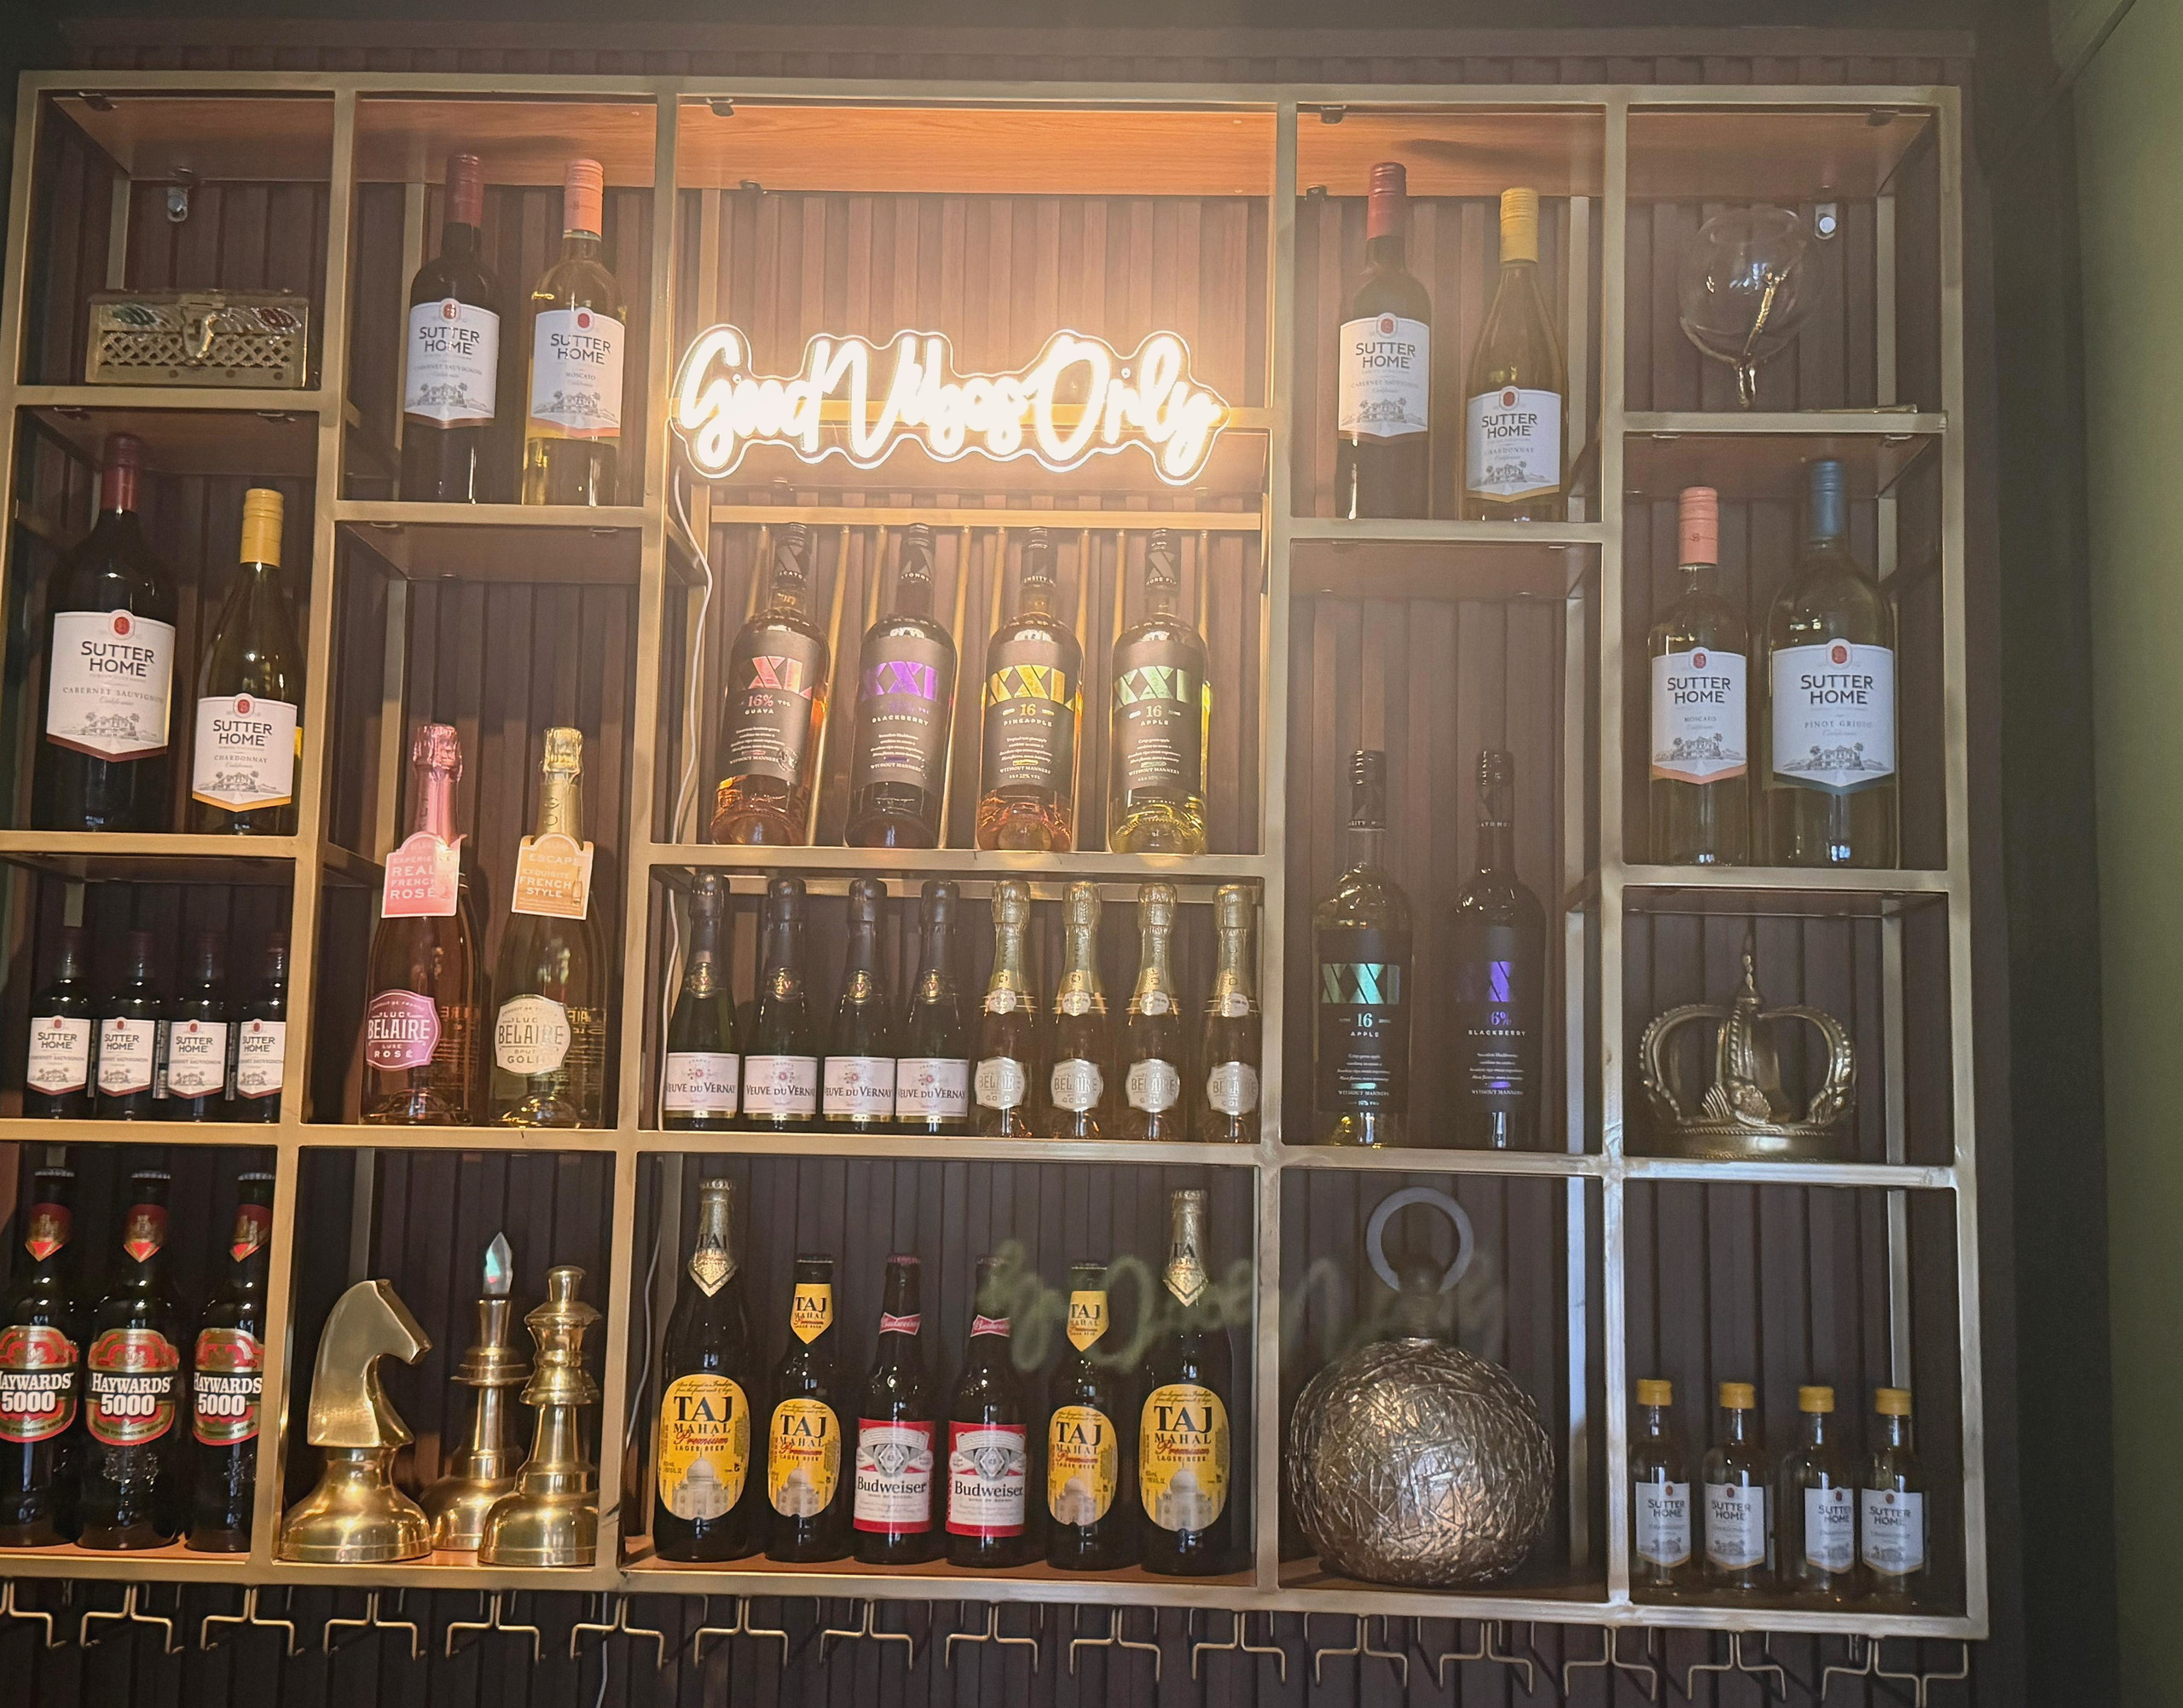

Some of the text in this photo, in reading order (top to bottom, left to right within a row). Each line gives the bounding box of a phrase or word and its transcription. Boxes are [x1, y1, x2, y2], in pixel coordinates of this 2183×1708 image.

[419, 327, 480, 344] SUTTER
[425, 340, 472, 355] HOME
[551, 333, 611, 354] SUTTER
[1356, 342, 1416, 357] SUTTER
[558, 348, 605, 364] HOME
[1362, 356, 1410, 369] HOME
[678, 330, 828, 468] Good
[1022, 335, 1222, 478] Only
[1482, 414, 1537, 428] SUTTER
[1487, 426, 1532, 439] HOME
[81, 641, 154, 663] SUTTER
[90, 658, 147, 677] HOME
[1667, 677, 1731, 691] SUTTER
[1800, 675, 1874, 690] SUTTER
[748, 694, 773, 708] 16%
[1674, 692, 1725, 704] HOME
[1810, 691, 1868, 704] HOME
[1020, 703, 1037, 716] 16
[1146, 704, 1162, 718] 16
[213, 720, 272, 735] SUTTER
[871, 715, 929, 726] BLACKBERRY
[1004, 718, 1052, 727] PINEAPPLE
[218, 733, 265, 746] HOME
[529, 854, 580, 866] ESCAPE
[392, 866, 435, 877] REAL
[522, 868, 571, 878] EXQUISITE
[519, 876, 571, 889] FRENCH
[526, 887, 563, 898] STYLE
[1358, 1012, 1373, 1028] 16
[368, 1019, 430, 1040] BELAIRE
[38, 1032, 77, 1042] SUTTER
[104, 1034, 140, 1043] SUTTER
[176, 1036, 213, 1045] SUTTER
[242, 1036, 275, 1045] SUTTER
[704, 1083, 736, 1094] VERNAY
[746, 1086, 770, 1095] VEUVE
[860, 1086, 892, 1097] VERNAY
[934, 1088, 965, 1099] VERNAY
[796, 1297, 826, 1312] TAJ
[1070, 1303, 1100, 1319] TAJ
[91, 1372, 171, 1394] HAYWARDS
[194, 1371, 263, 1394] HAYWARDS
[2, 1391, 56, 1412] 5000
[101, 1394, 156, 1416] 5000
[198, 1395, 246, 1416] 5000
[673, 1395, 732, 1422] TAJ
[1154, 1405, 1213, 1433] TAJ
[673, 1423, 731, 1433] MAHAL
[780, 1415, 827, 1438] TAJ
[1056, 1421, 1102, 1446] TAJ
[674, 1430, 728, 1445] Premium
[779, 1436, 825, 1447] MAHAL
[1154, 1432, 1212, 1445] MAHAL
[1056, 1443, 1100, 1455] MAHAL
[1155, 1439, 1209, 1455] Premium
[857, 1476, 927, 1494] Budweiser
[1647, 1499, 1685, 1508] SUTTER
[1711, 1500, 1752, 1512] SUTTER
[1716, 1510, 1746, 1520] HOME
[1869, 1506, 1911, 1517] SUTTER
